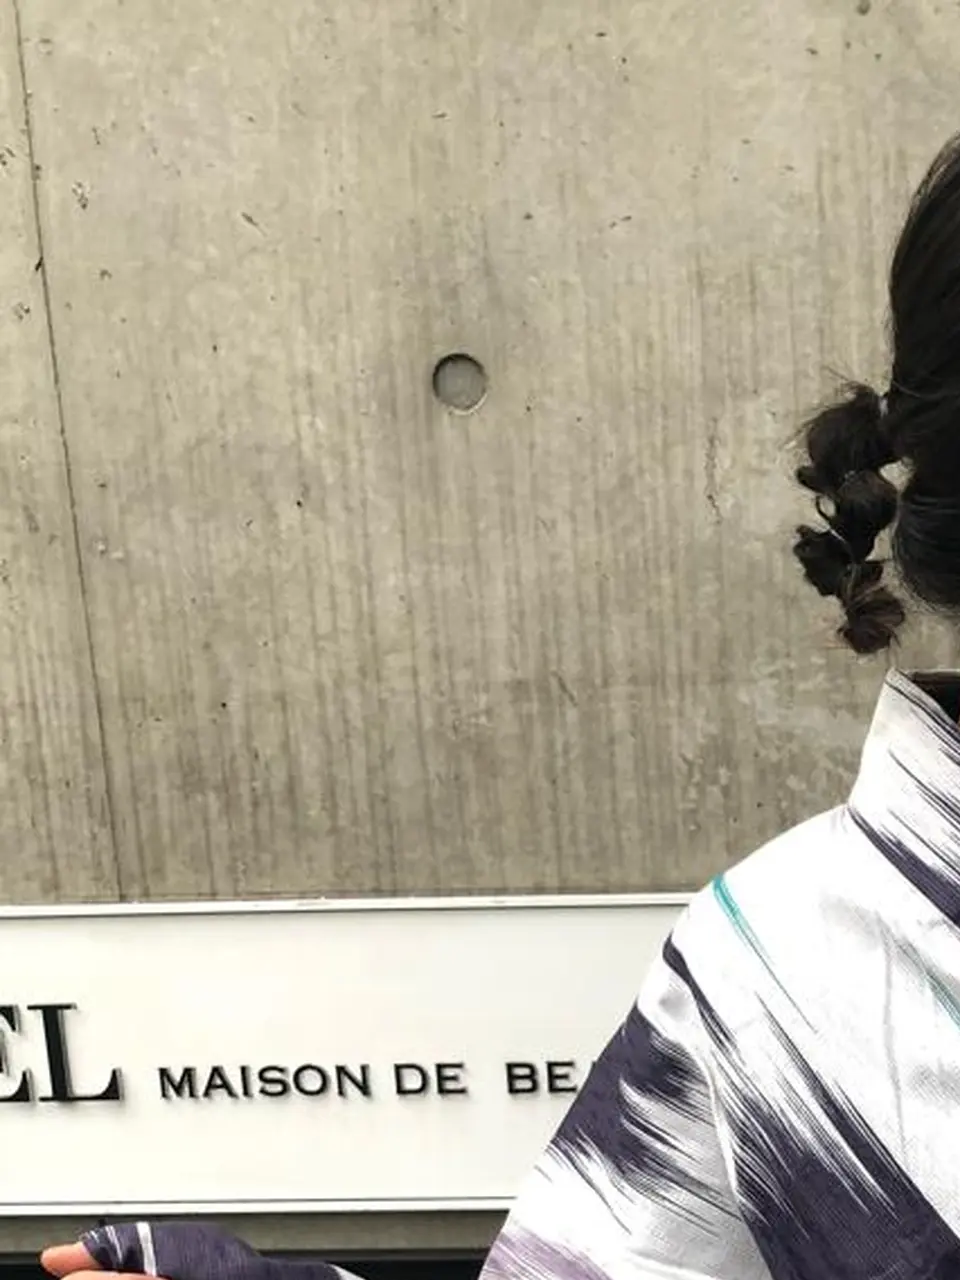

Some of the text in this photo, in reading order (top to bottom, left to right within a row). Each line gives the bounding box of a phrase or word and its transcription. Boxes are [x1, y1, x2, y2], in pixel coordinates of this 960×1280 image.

[158, 1063, 371, 1099] MAISON
[394, 1062, 468, 1096] DE
[505, 1060, 598, 1095] BE
